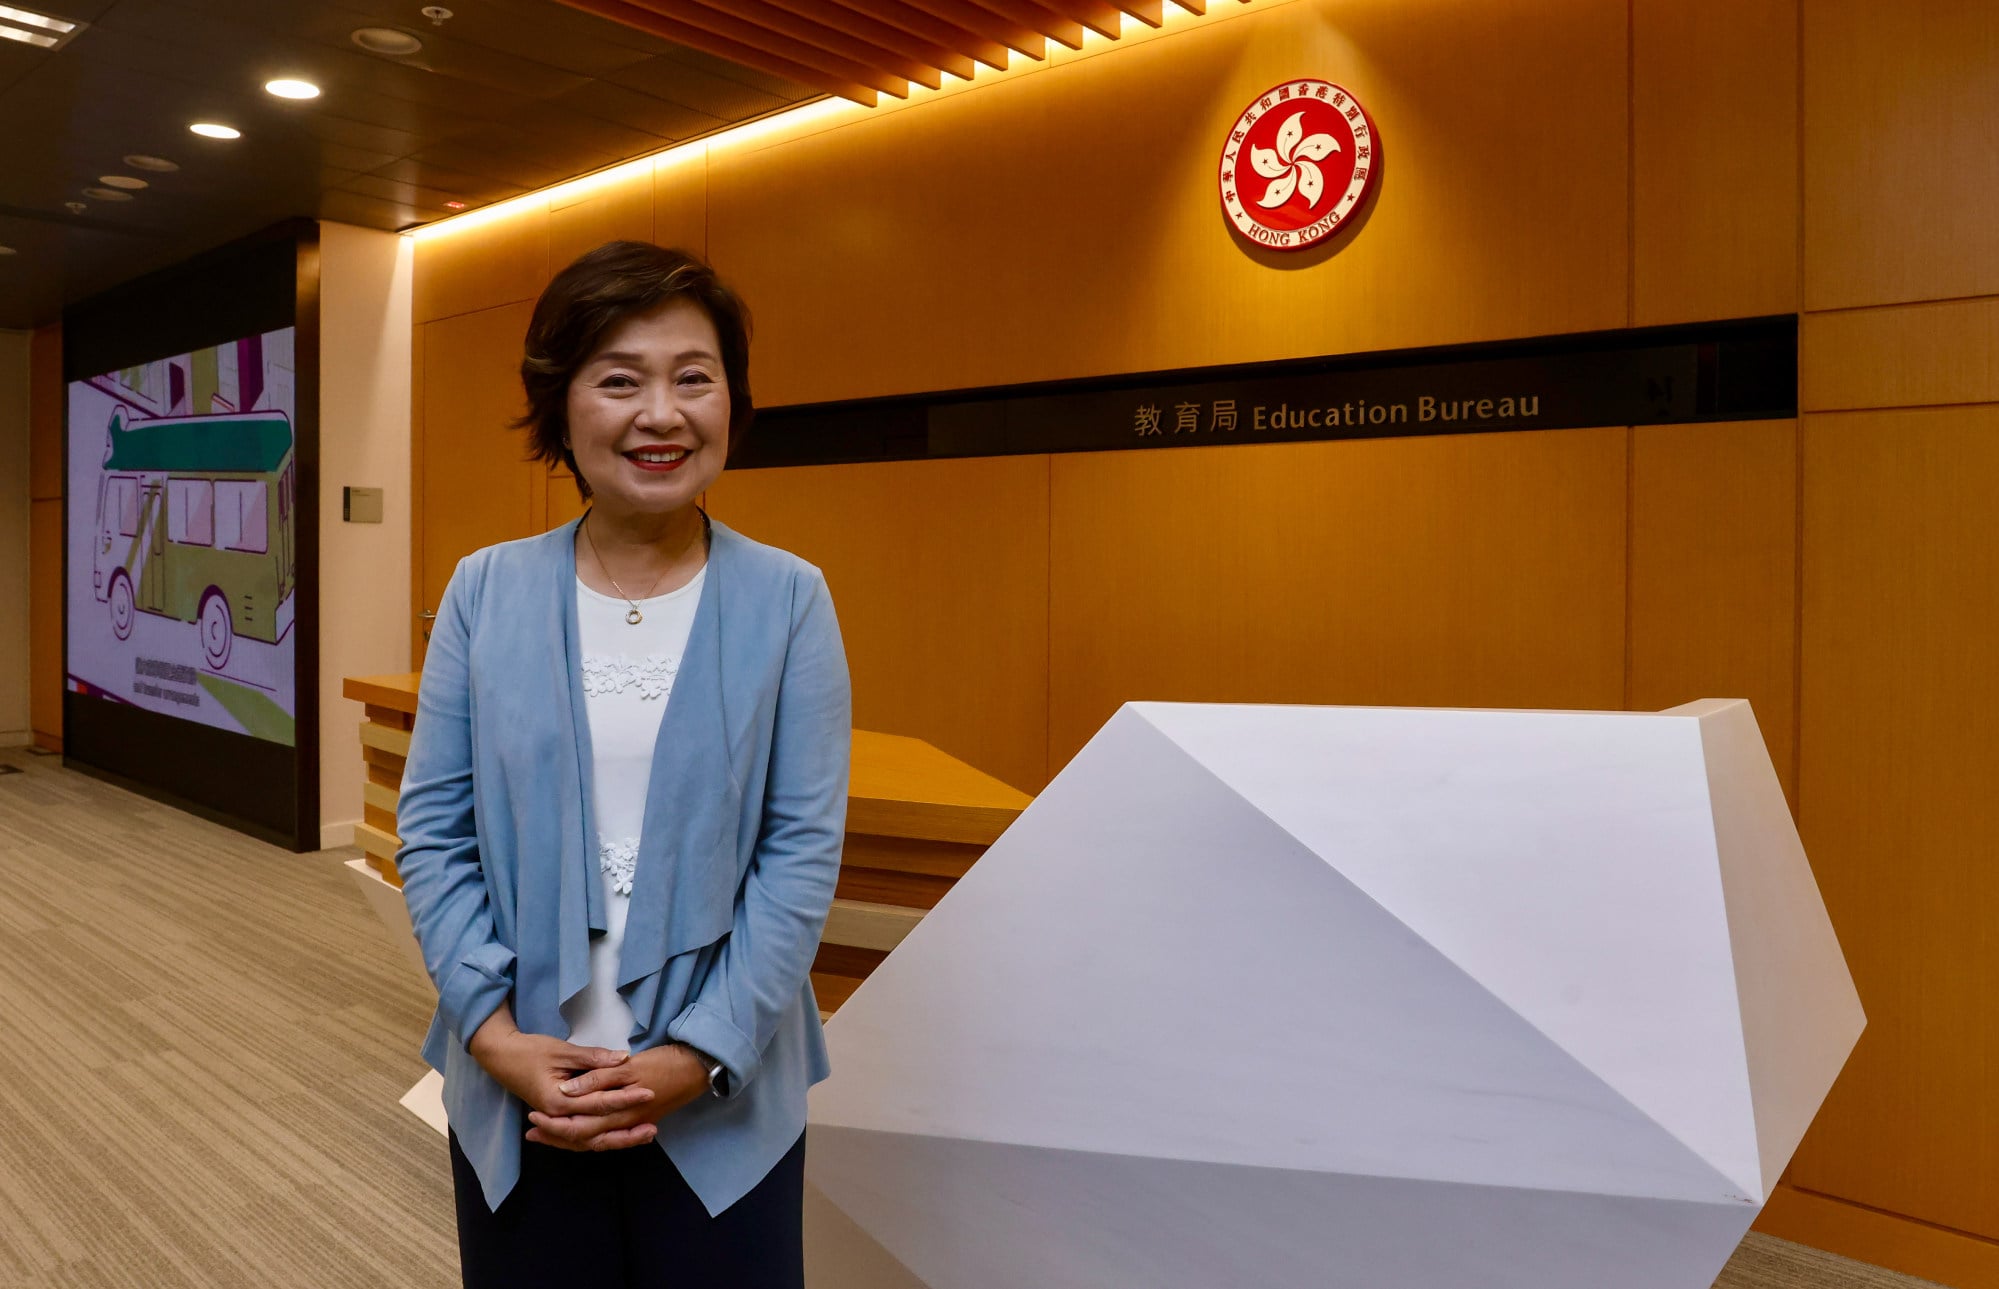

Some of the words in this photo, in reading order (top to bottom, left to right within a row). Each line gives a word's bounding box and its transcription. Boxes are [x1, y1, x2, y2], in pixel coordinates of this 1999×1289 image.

[1223, 83, 1370, 203] 中華人民共和國香港特別行政區
[1248, 224, 1291, 245] HONG
[1298, 211, 1341, 243] KONG
[1134, 400, 1238, 437] 教育局
[1253, 400, 1408, 430] Education
[1418, 395, 1540, 423] Bureau
